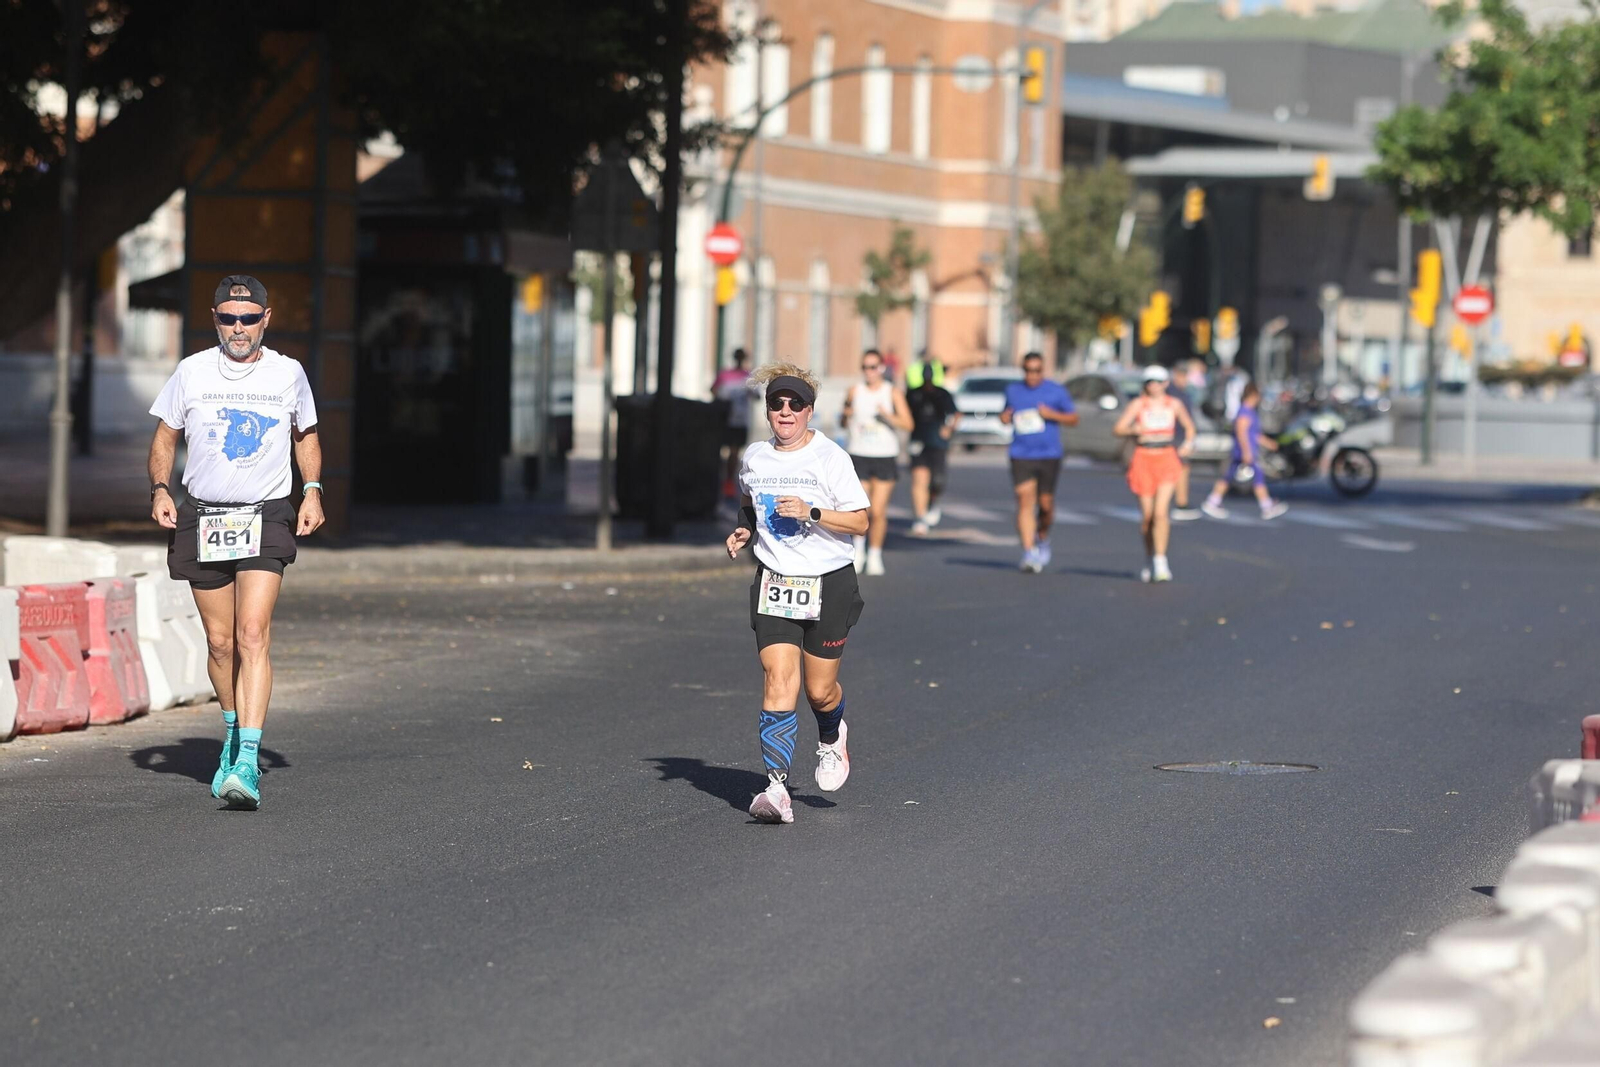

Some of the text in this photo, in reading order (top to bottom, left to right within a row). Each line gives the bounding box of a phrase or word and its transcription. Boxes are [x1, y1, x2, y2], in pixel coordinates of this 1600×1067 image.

[246, 394, 284, 403] SOLIDARIO
[779, 477, 818, 486] SOLIDARIO
[208, 530, 250, 546] 461
[768, 586, 810, 606] 310
